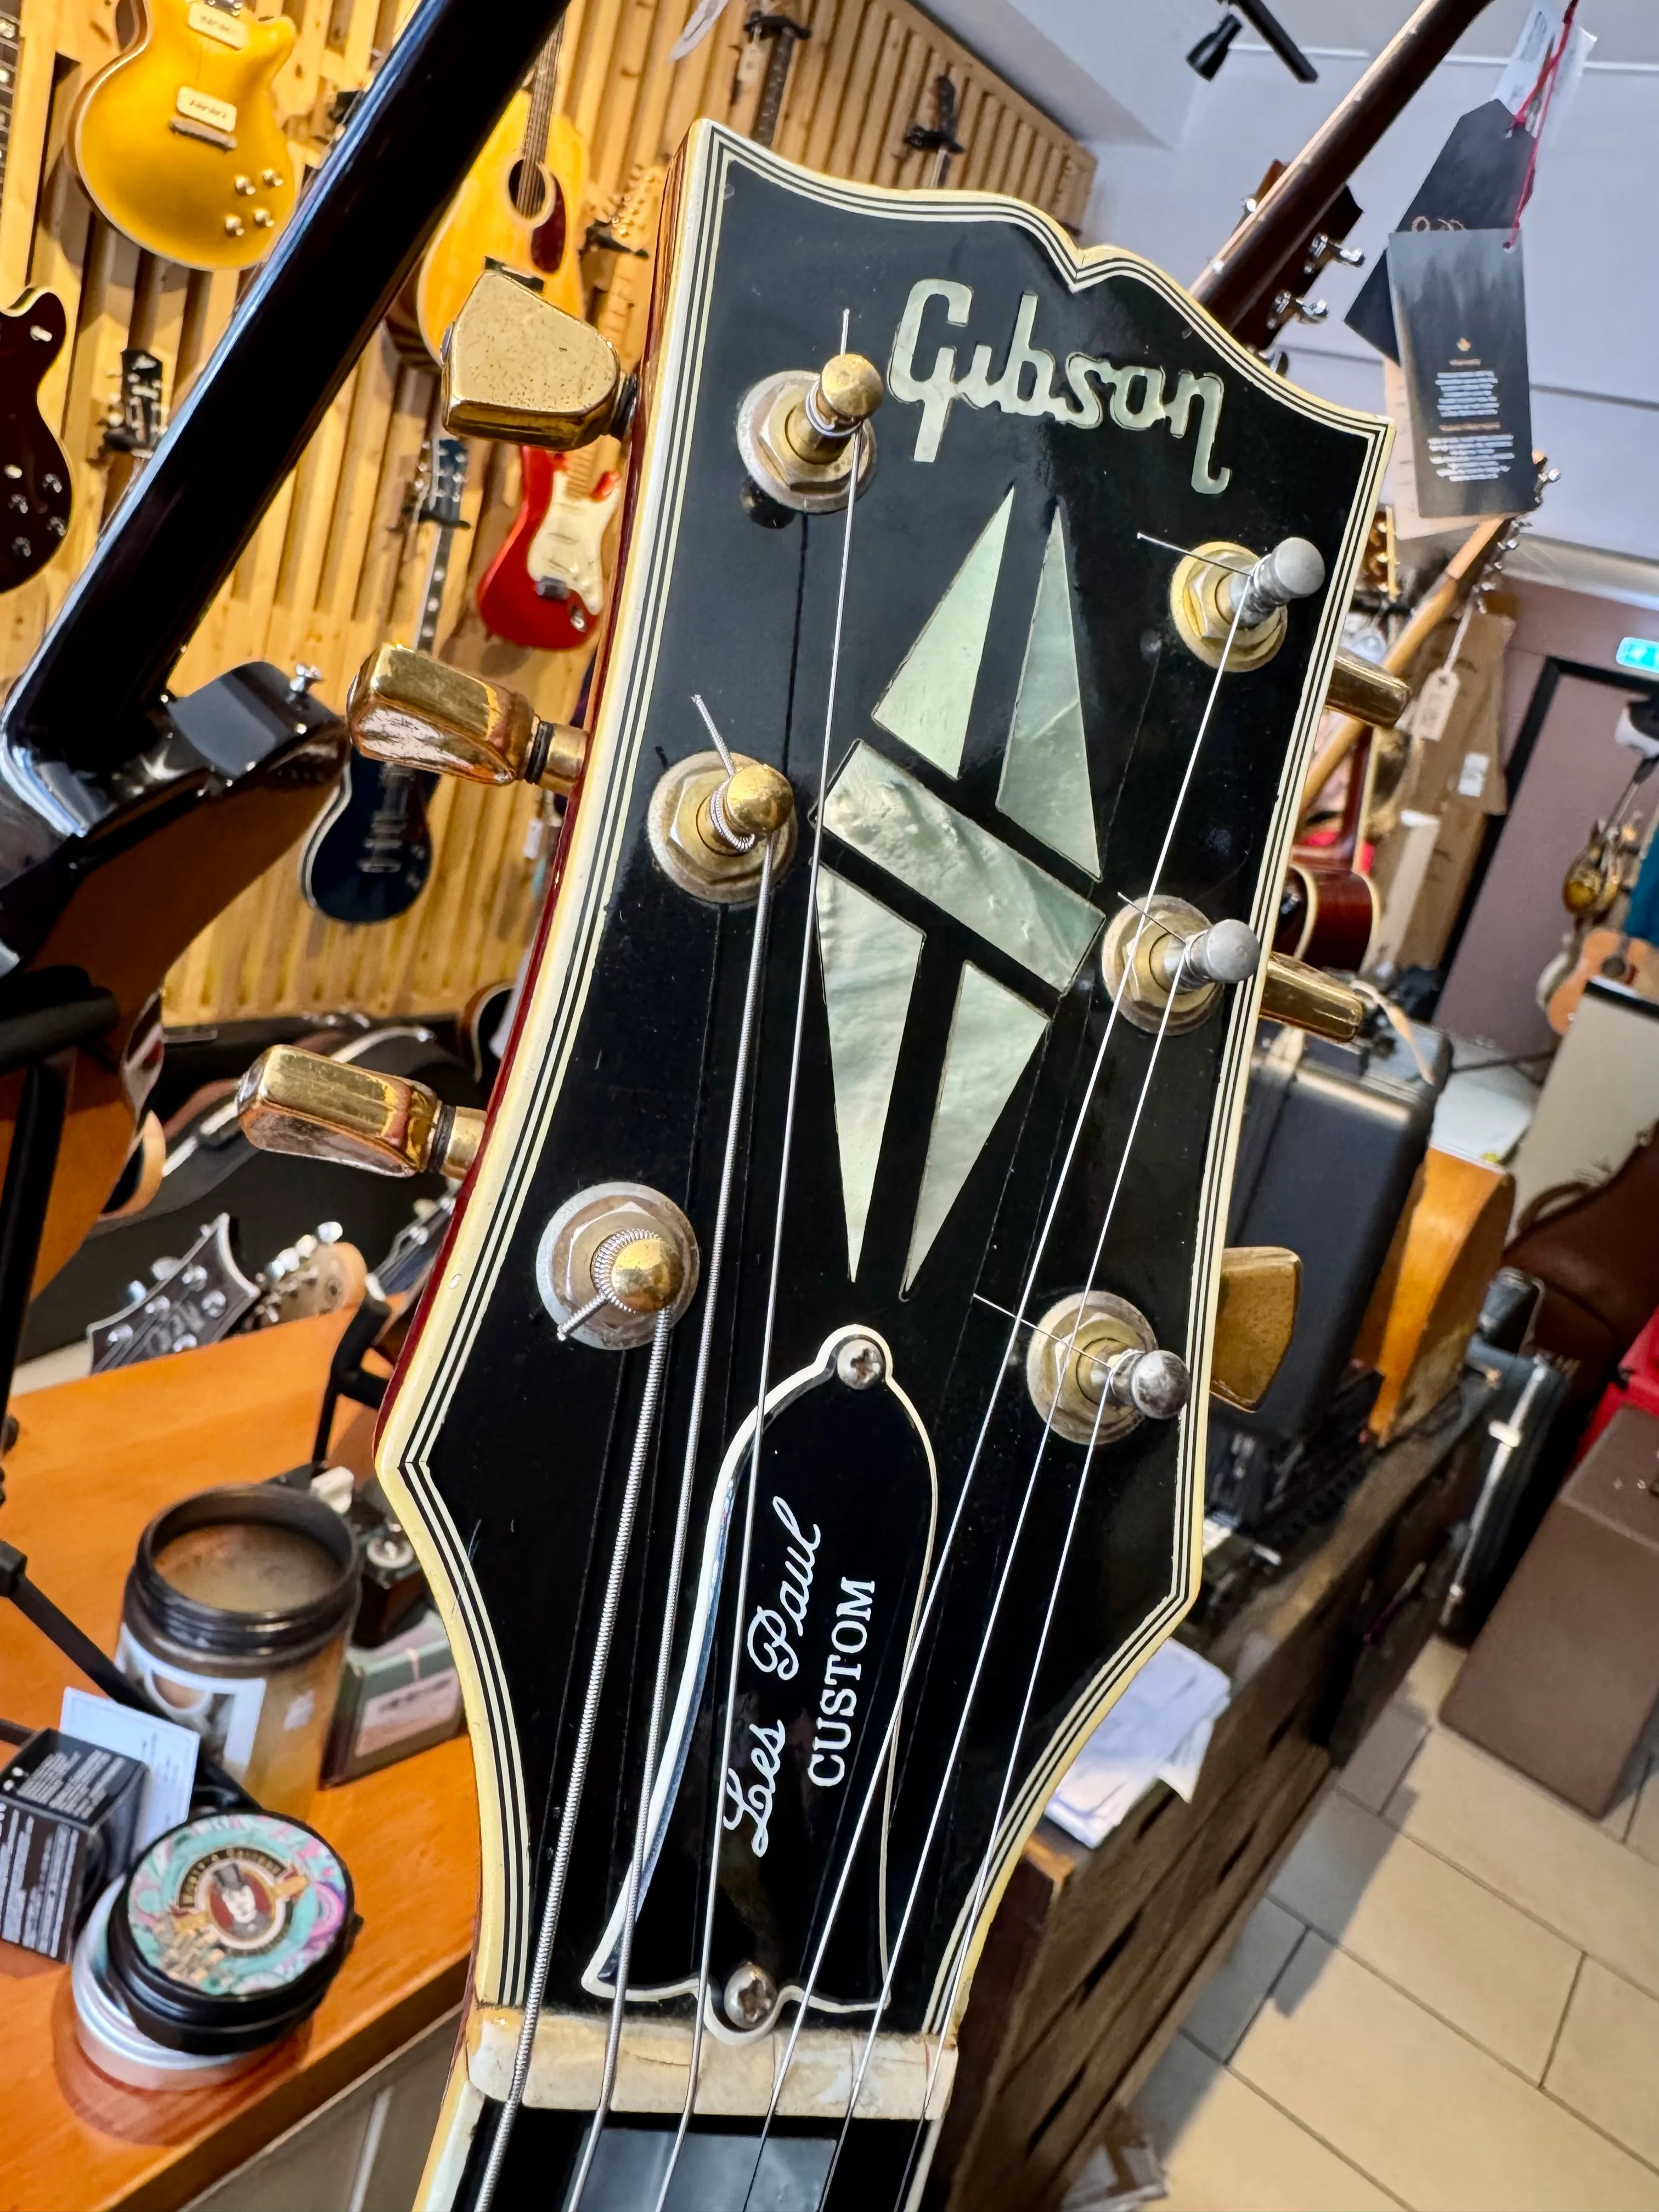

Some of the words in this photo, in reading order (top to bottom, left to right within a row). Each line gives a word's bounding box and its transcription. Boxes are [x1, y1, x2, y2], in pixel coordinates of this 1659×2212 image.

[888, 279, 1232, 494] Gibson
[747, 1496, 821, 1680] Paul
[808, 1577, 875, 1787] CUSTOM
[724, 1719, 786, 1857] Les
